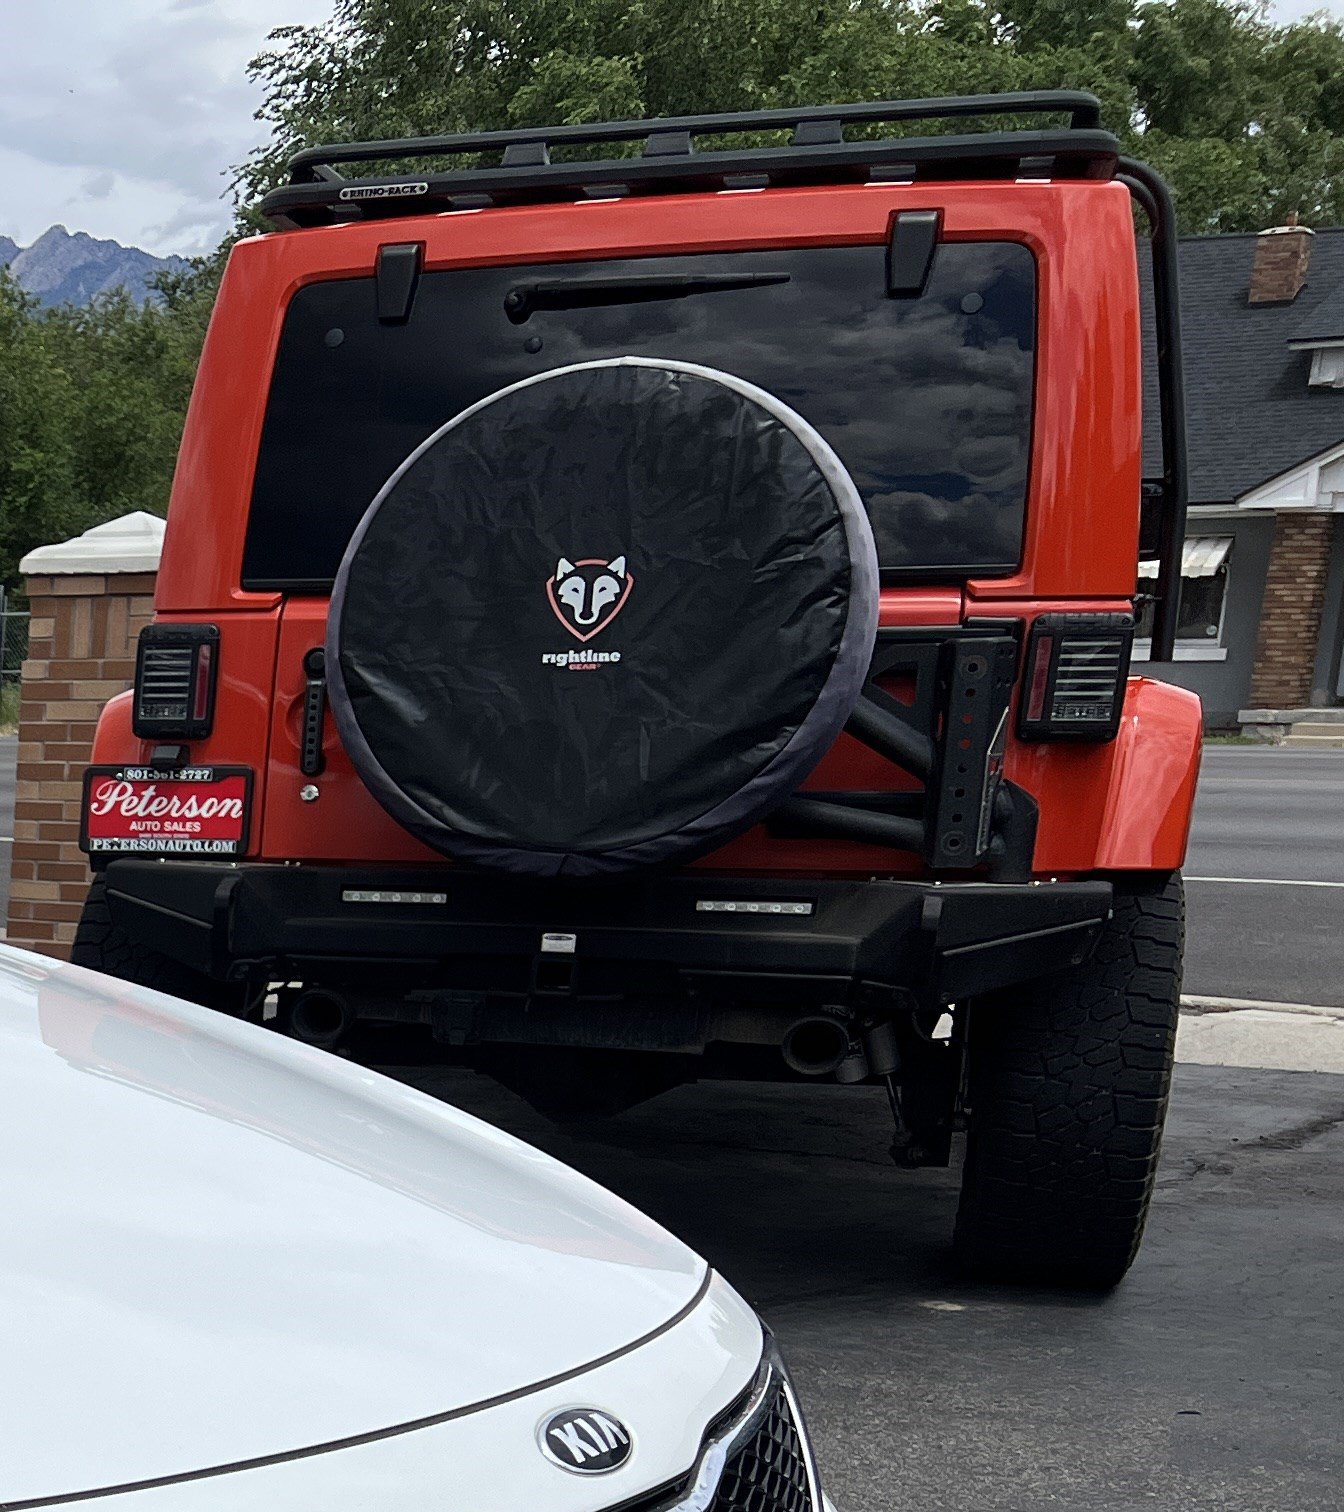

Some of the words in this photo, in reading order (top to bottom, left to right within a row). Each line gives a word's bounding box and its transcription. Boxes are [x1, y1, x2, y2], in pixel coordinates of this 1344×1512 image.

[349, 184, 418, 198] RHINO-RACK
[542, 649, 621, 667] rightline
[90, 780, 243, 819] Peterson
[129, 820, 161, 832] AUTO
[163, 821, 201, 832] SALES
[549, 1412, 629, 1464] KIA
